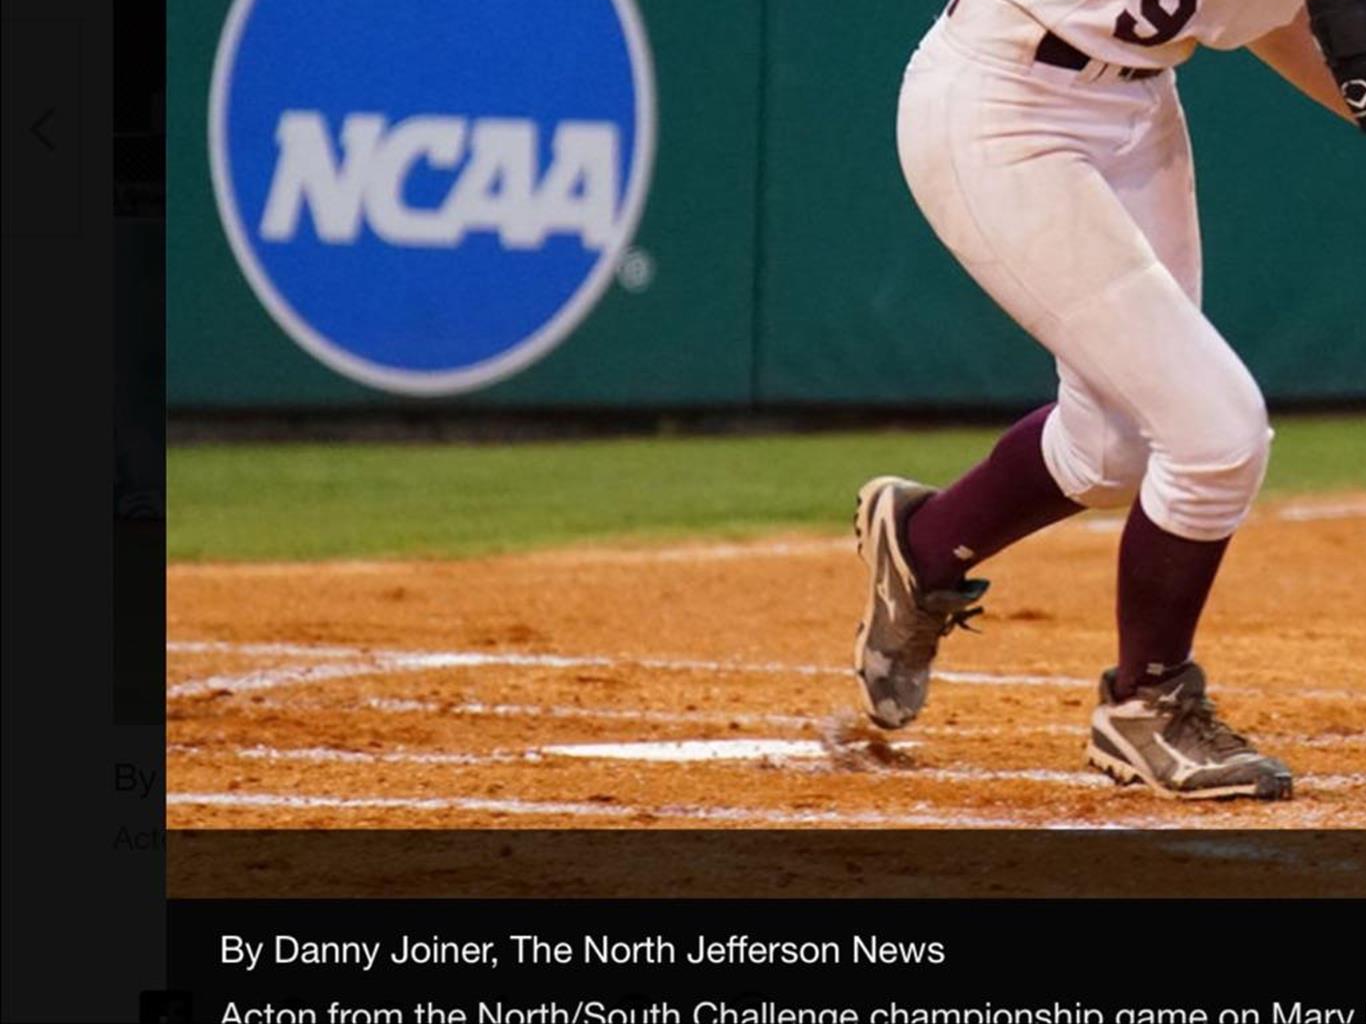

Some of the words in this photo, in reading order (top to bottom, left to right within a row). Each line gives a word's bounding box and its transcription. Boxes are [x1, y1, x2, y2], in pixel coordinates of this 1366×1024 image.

[259, 109, 622, 253] NCAA
[114, 762, 157, 800] By
[113, 825, 164, 851] Act
